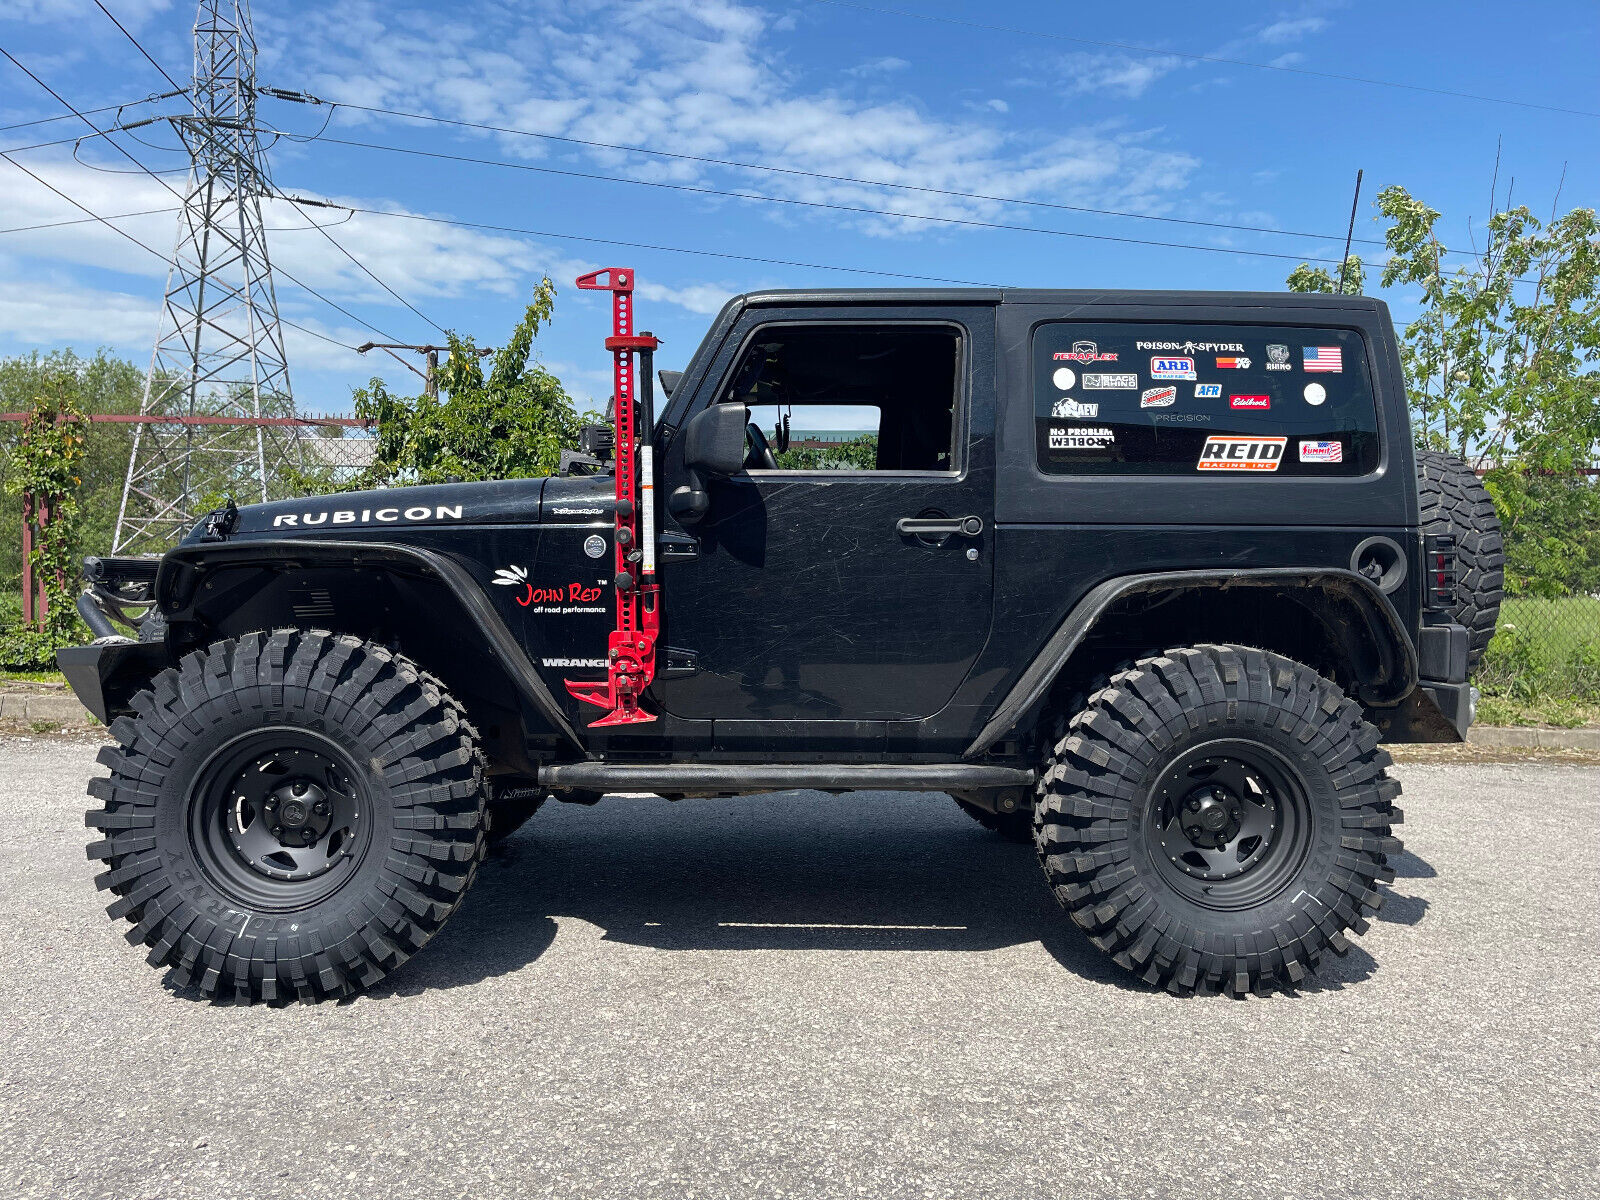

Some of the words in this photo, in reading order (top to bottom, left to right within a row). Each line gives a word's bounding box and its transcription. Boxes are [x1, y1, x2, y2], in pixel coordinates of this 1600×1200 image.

[1136, 341, 1181, 351] POISON
[1199, 342, 1245, 353] SPYDER
[1053, 352, 1119, 361] TERAFLEX
[1156, 360, 1189, 371] ARB
[1266, 363, 1292, 371] RHINO
[1198, 385, 1219, 396] AFR
[1232, 397, 1268, 407] Edelbrock
[1077, 403, 1097, 416] AEV
[1050, 428, 1066, 436] NO
[1068, 428, 1113, 436] PROBLEM
[1202, 443, 1283, 460] REID
[273, 505, 463, 527] RUBICON
[516, 583, 564, 607] JOHN
[568, 582, 602, 602] RED
[545, 606, 561, 614] road
[562, 606, 606, 614] performance
